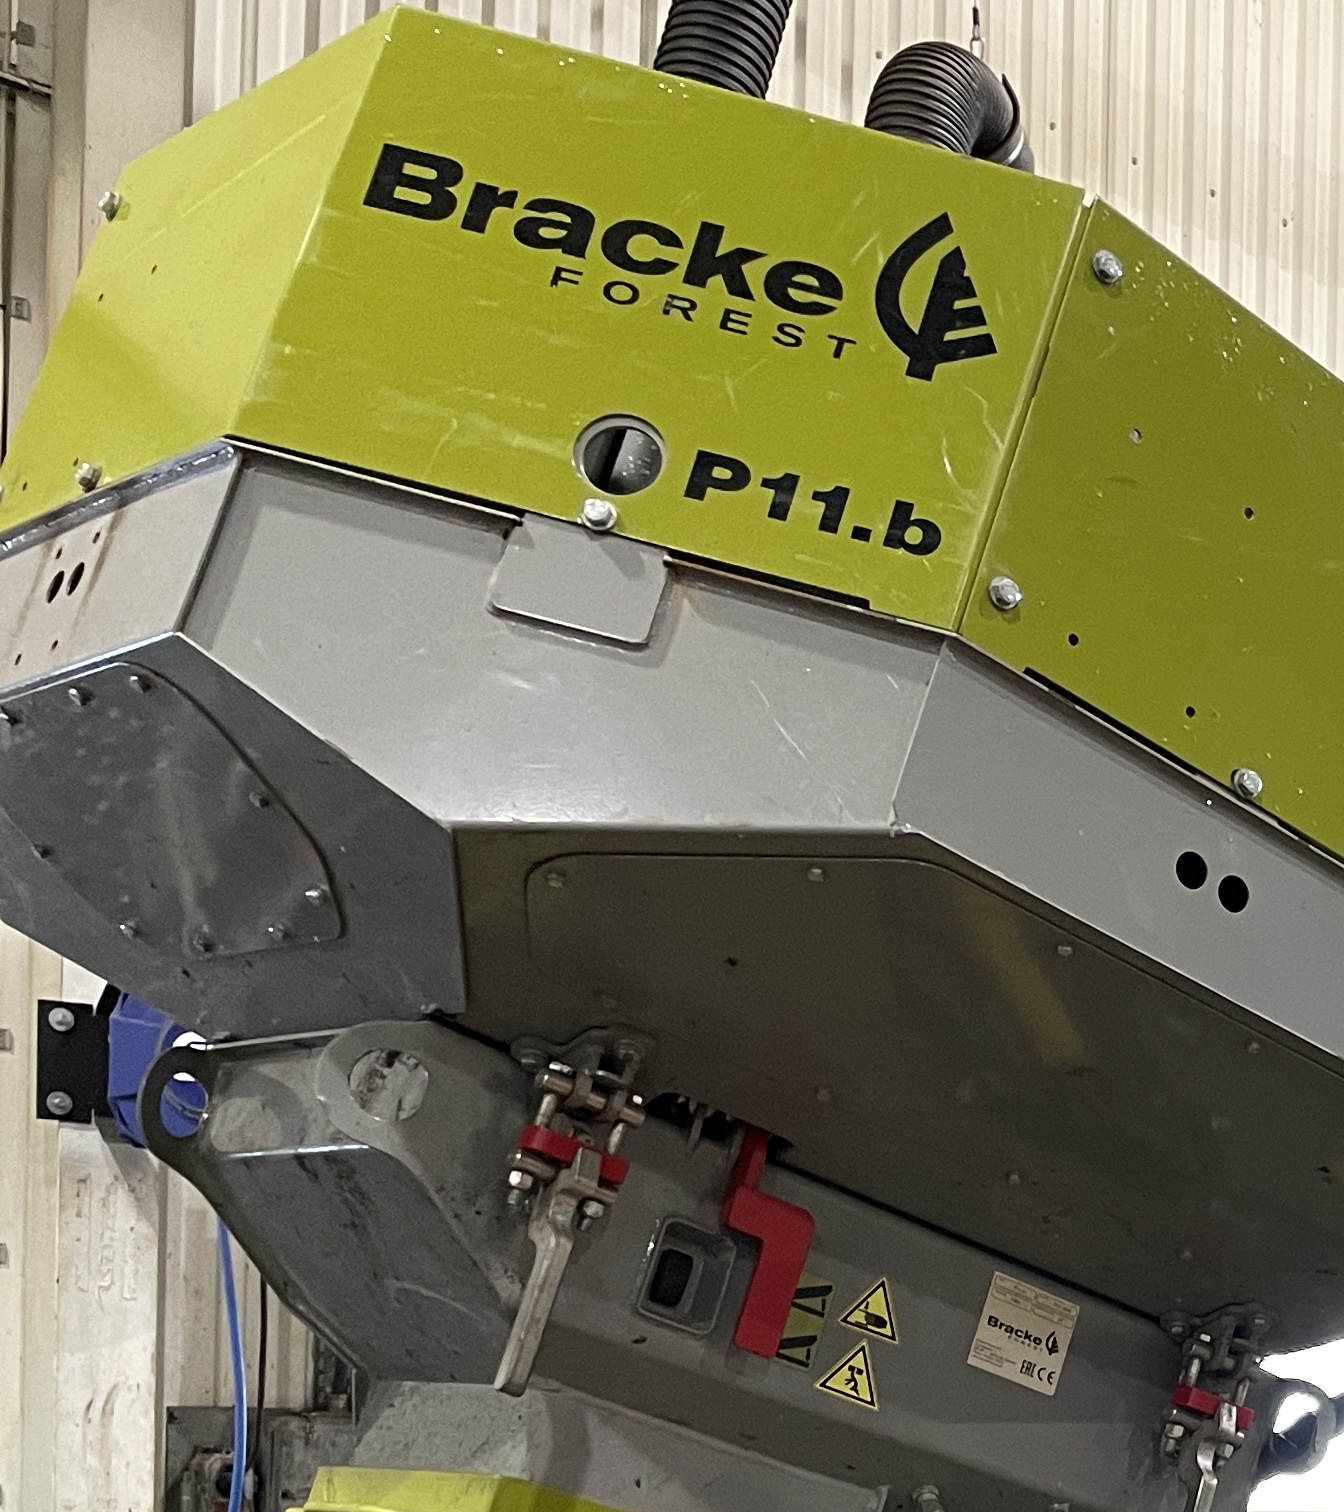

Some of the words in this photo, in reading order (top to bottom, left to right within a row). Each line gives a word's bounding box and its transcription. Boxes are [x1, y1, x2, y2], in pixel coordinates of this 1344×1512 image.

[363, 143, 843, 317] Bracke
[551, 265, 857, 359] FOREST
[683, 449, 943, 558] P11.b
[987, 1315, 1042, 1346] Bracke
